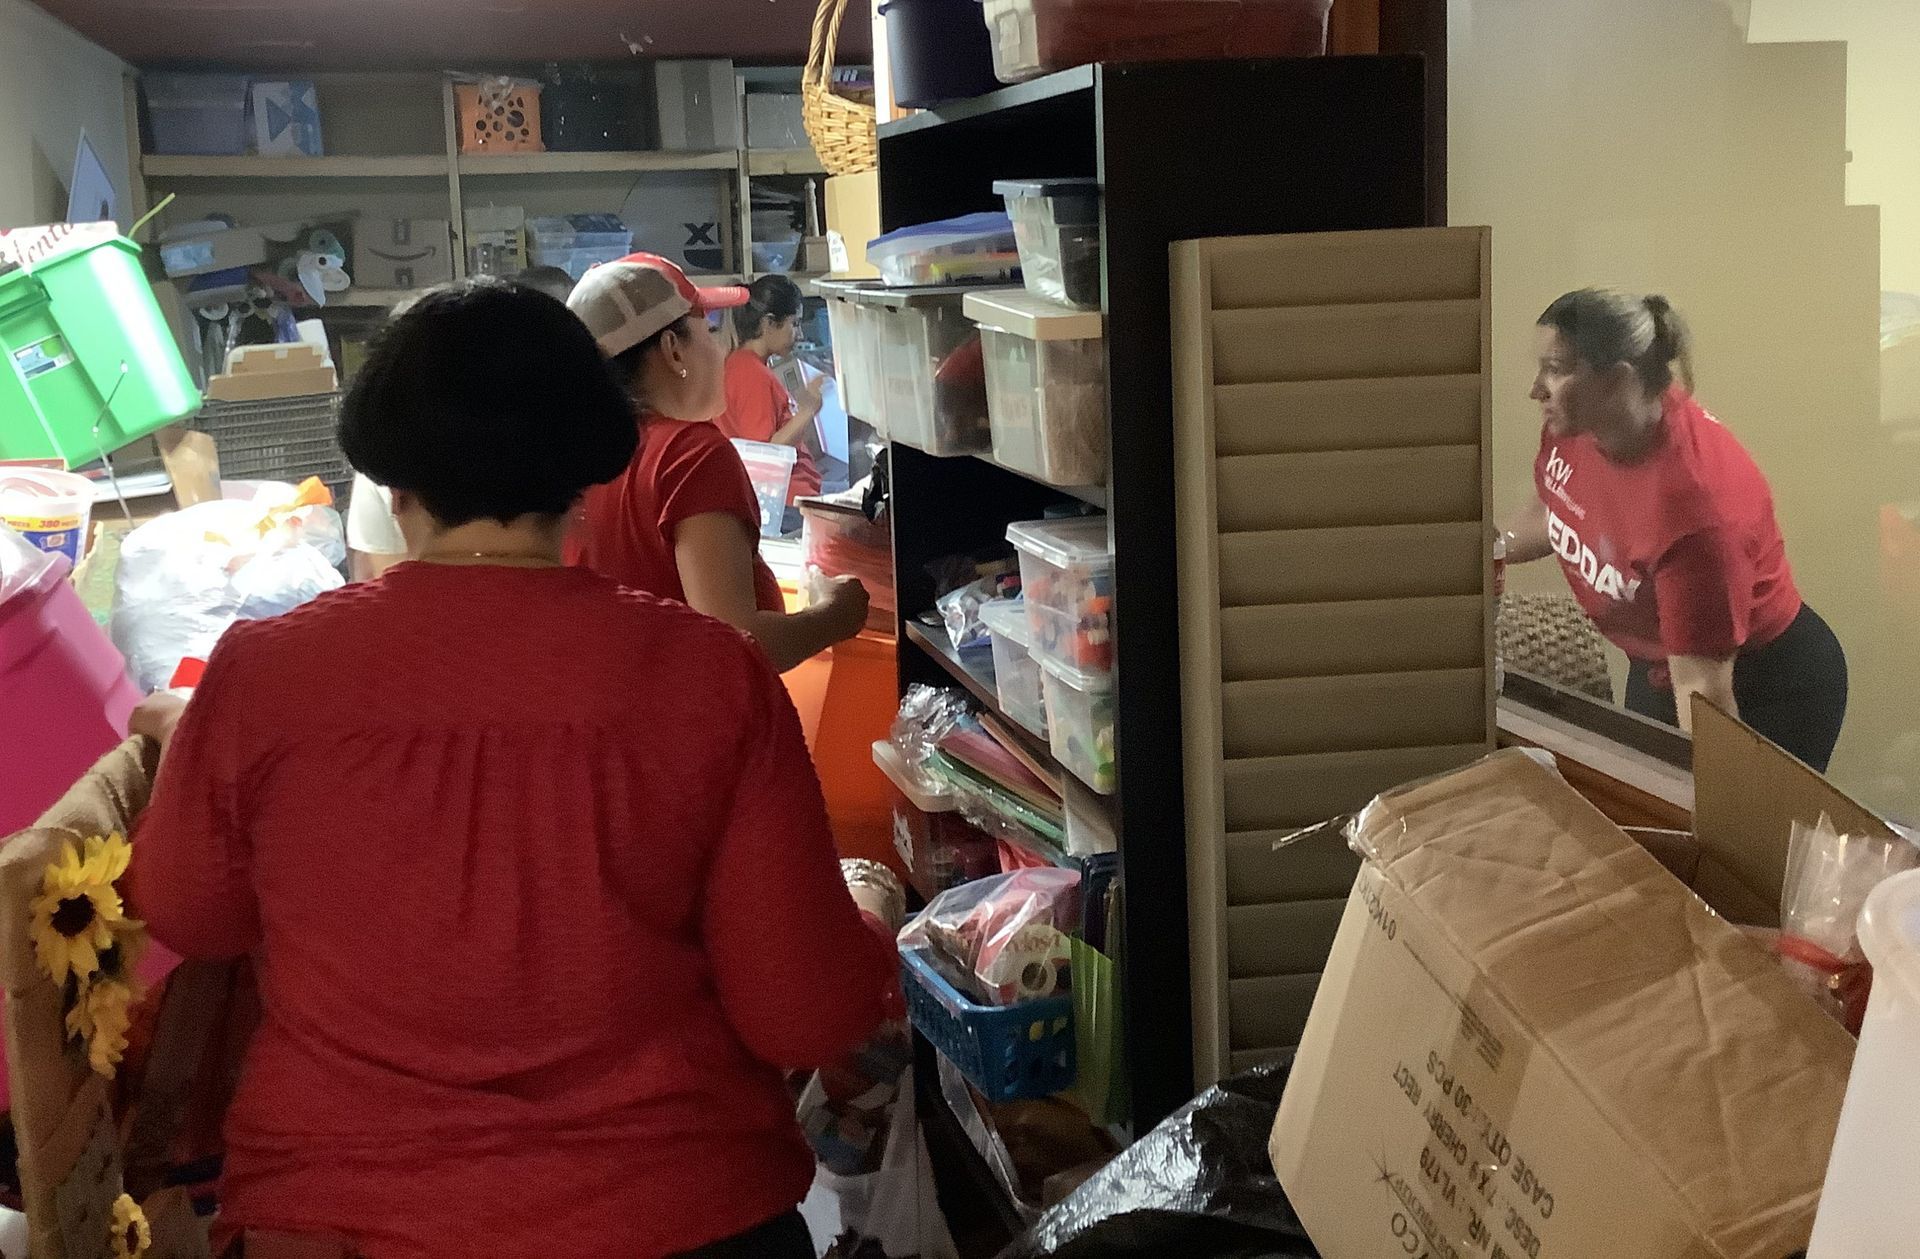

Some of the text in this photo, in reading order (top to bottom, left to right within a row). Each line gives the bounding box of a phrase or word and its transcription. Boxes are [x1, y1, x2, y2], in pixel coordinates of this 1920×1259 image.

[1546, 506, 1642, 601] EDDAY
[1427, 1050, 1455, 1096] PCS
[1454, 1085, 1472, 1117] 30
[1424, 1102, 1468, 1166] CHERRY
[1511, 1155, 1554, 1219] CASE
